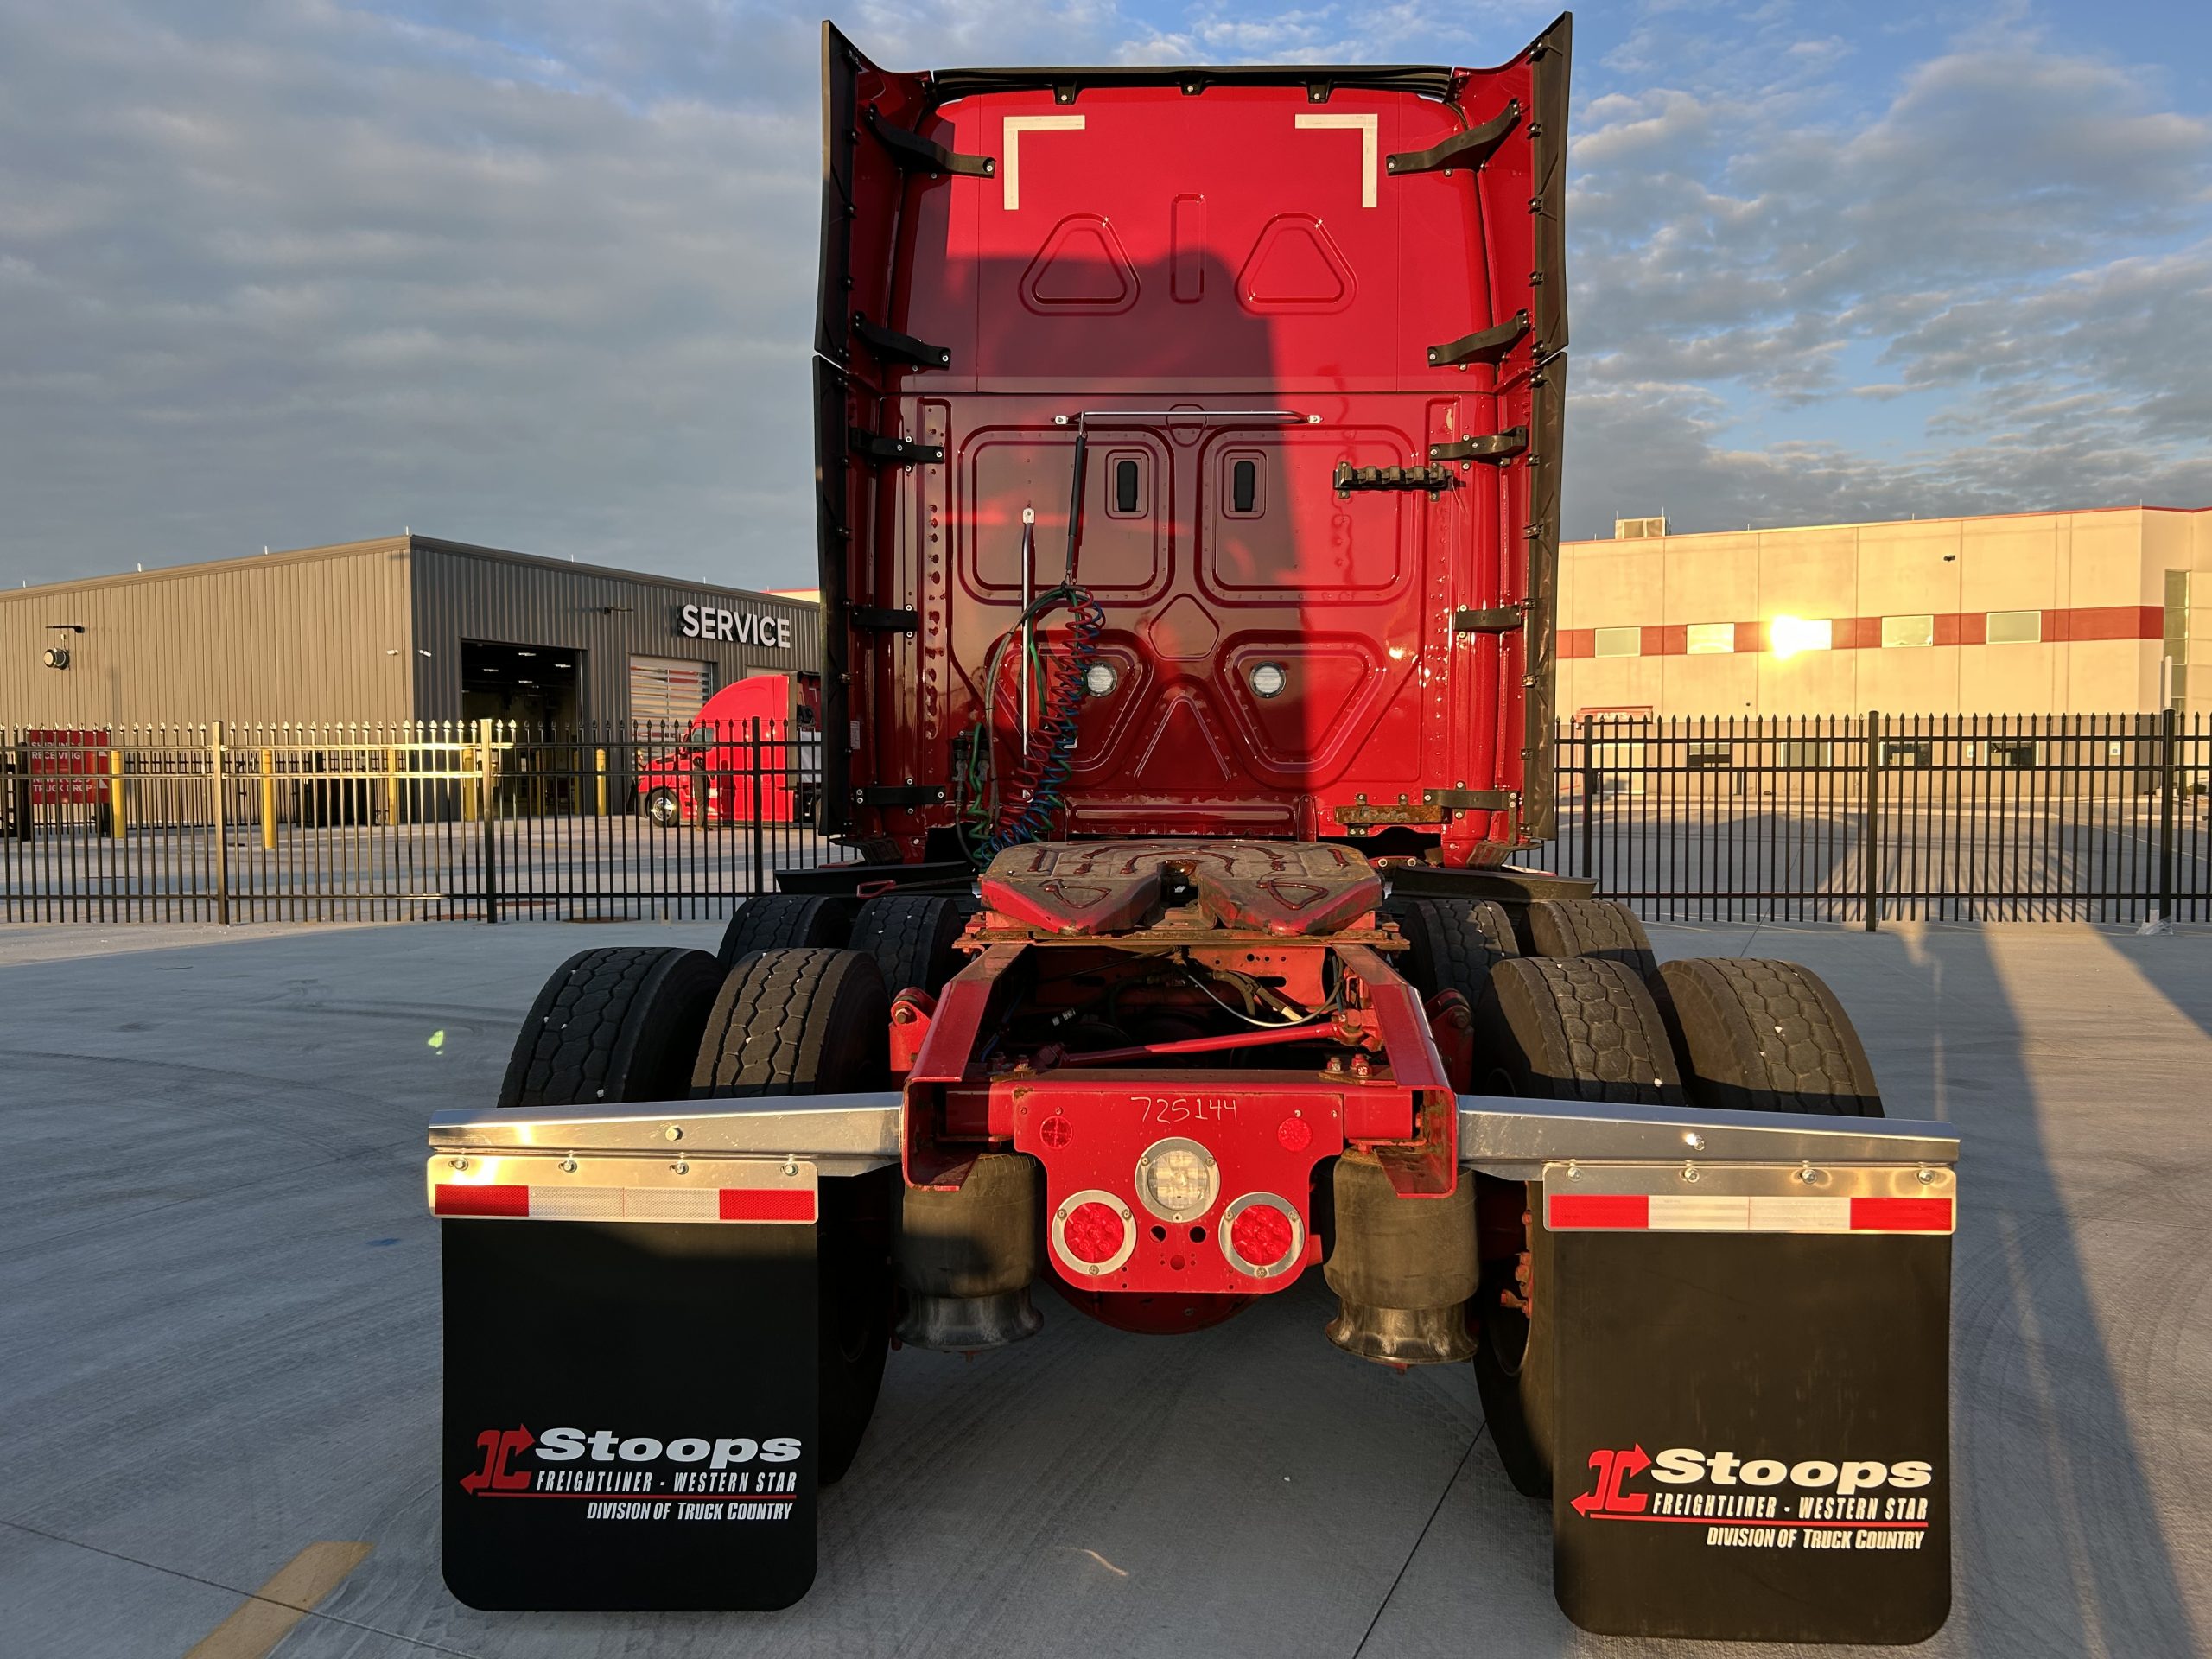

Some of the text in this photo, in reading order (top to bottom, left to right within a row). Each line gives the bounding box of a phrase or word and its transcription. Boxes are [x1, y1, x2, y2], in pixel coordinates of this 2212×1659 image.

[683, 604, 791, 648] SERVICE
[31, 751, 81, 760] RECEVIG
[1130, 1096, 1236, 1124] 725144
[535, 1427, 802, 1469] Stoops
[536, 1471, 652, 1492] FREIGHTLINER
[673, 1471, 749, 1492] WESTERN
[755, 1471, 797, 1492] STAR
[1650, 1448, 1932, 1495] Stoops
[587, 1502, 793, 1521] DIVISION OF TRUCK COUNTRY
[1652, 1492, 1777, 1518] FREIGHTLINER
[1798, 1497, 1878, 1520] WESTERN
[1885, 1497, 1929, 1521] STAR
[1707, 1526, 1925, 1550] DIVISION OF TRUCK COUNTRY
